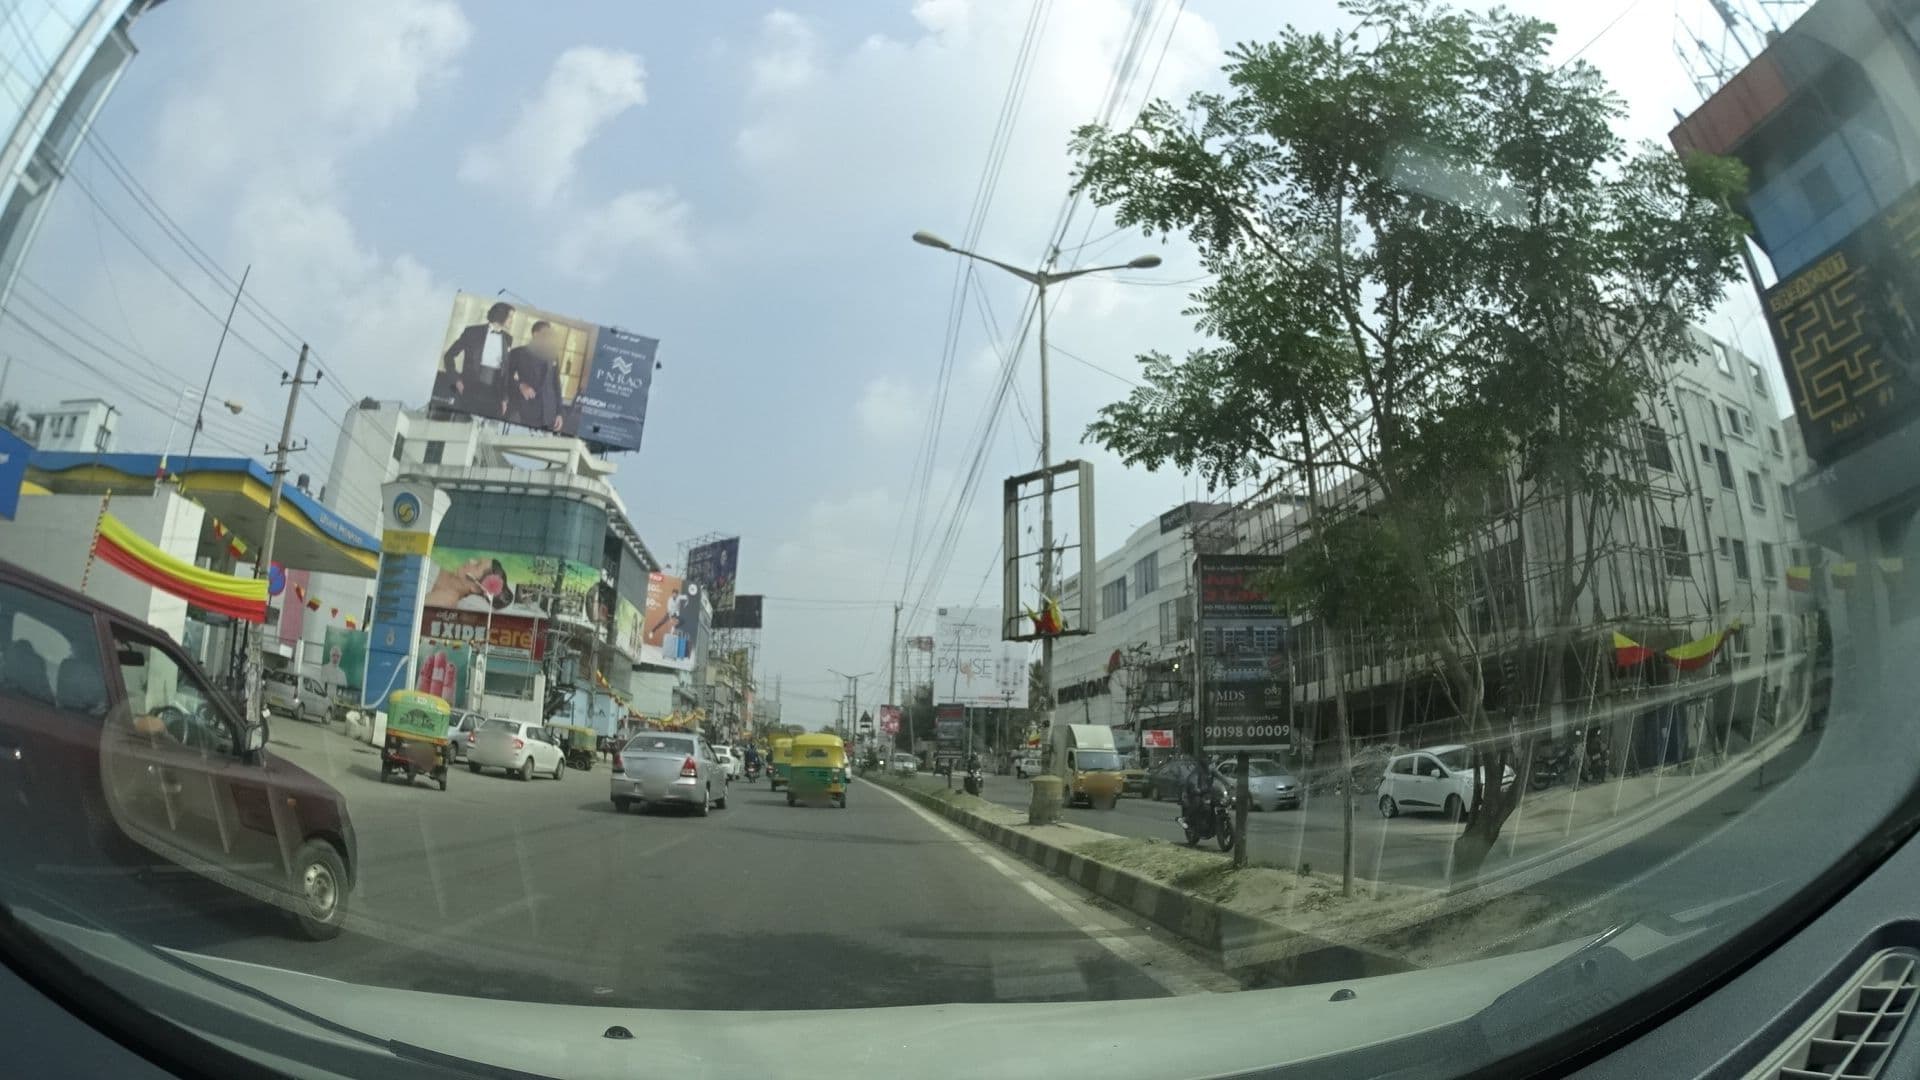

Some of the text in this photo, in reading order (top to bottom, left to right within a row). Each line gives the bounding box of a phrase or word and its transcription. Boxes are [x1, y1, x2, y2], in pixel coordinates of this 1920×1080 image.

[431, 621, 486, 641] EXIDE
[489, 629, 532, 648] care
[1216, 690, 1245, 701] MDS
[1205, 725, 1290, 738] 90198 00009
